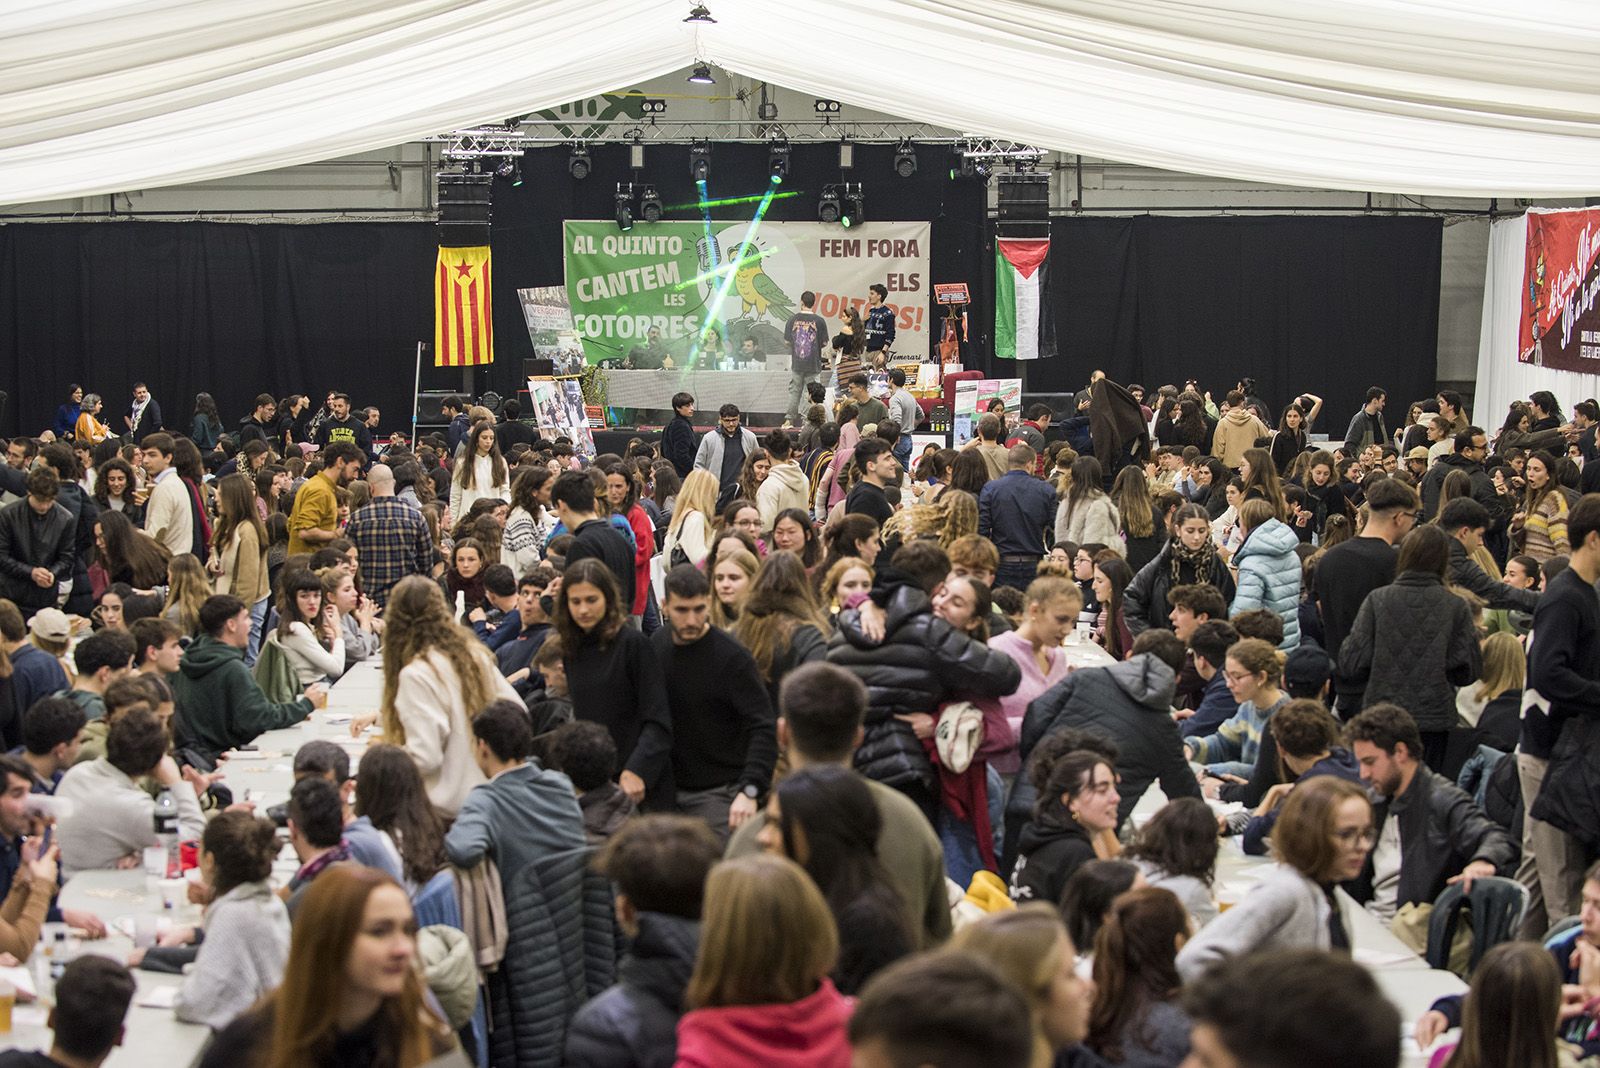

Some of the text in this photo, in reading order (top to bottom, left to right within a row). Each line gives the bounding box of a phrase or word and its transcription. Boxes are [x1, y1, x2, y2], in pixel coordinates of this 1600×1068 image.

[573, 235, 683, 257] AL QUINTO
[820, 239, 920, 258] FEM FORA
[576, 261, 681, 302] CANTEM
[887, 273, 920, 292] ELS
[664, 294, 686, 306] LES
[574, 314, 699, 339] COTORRES
